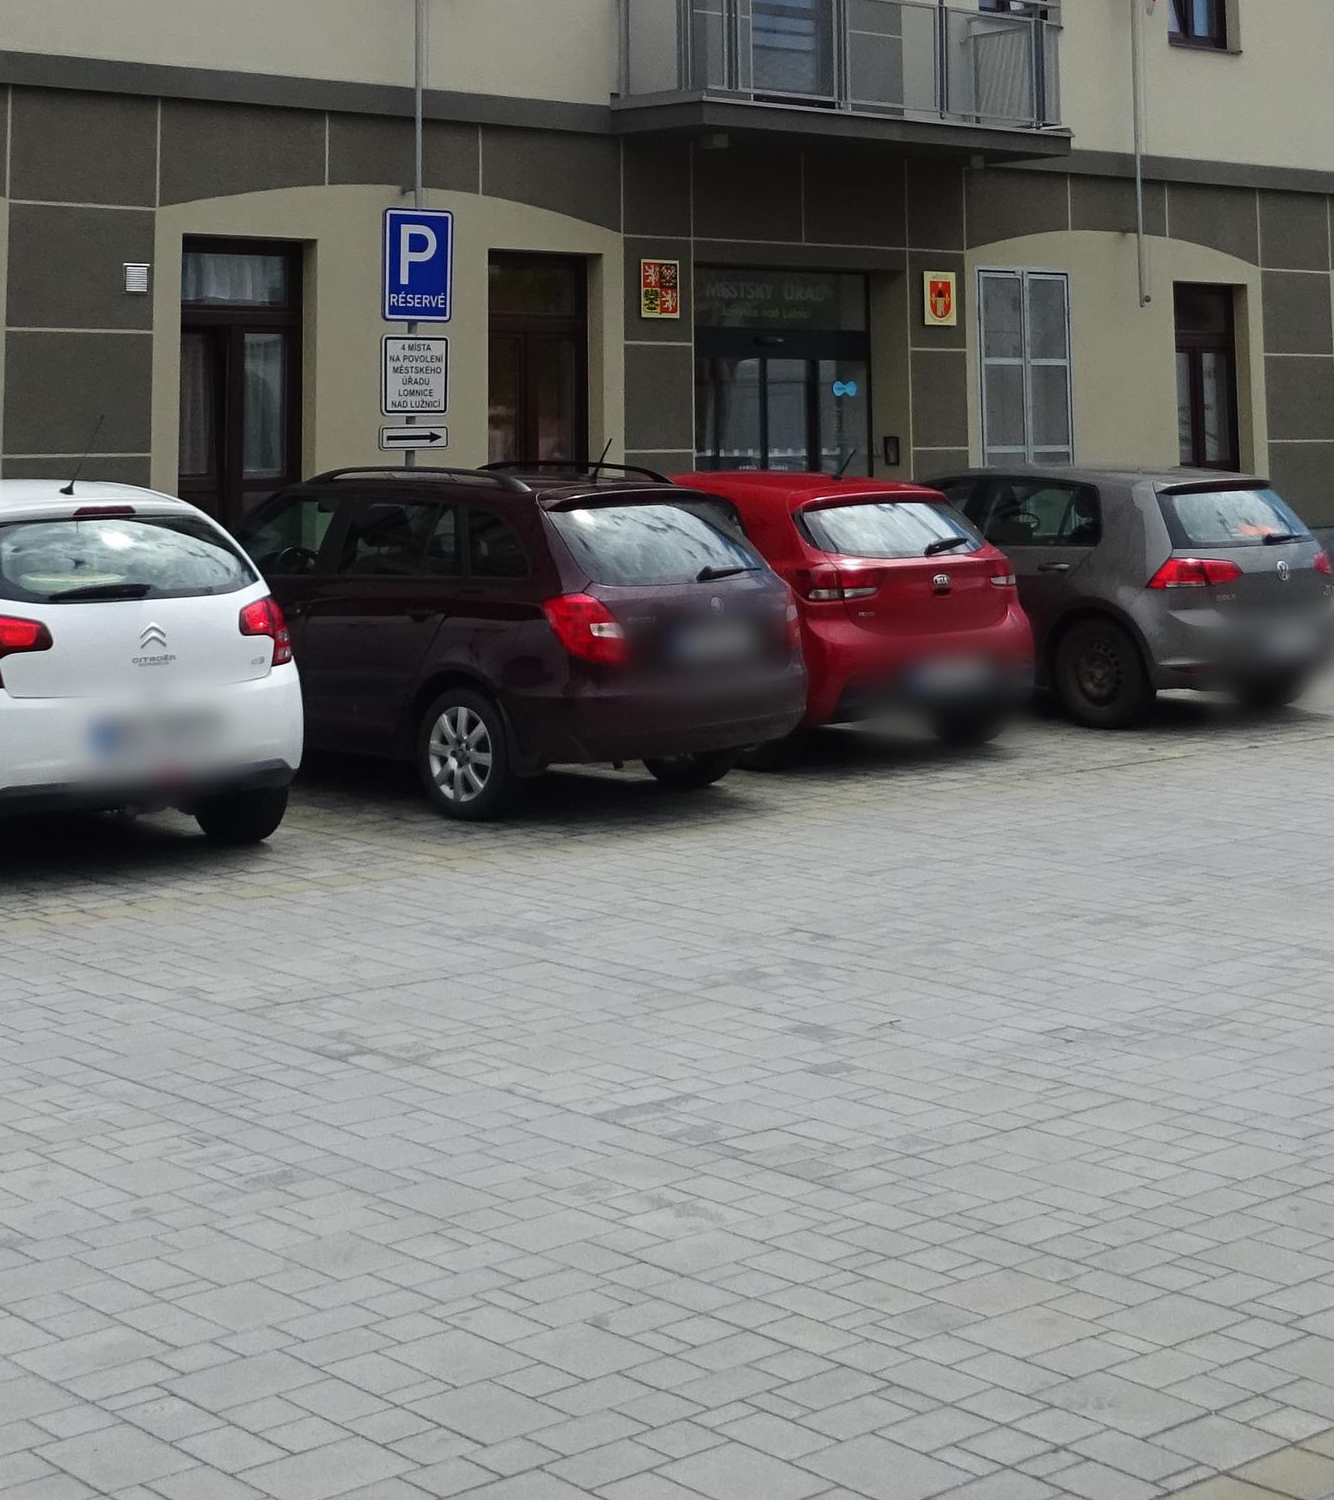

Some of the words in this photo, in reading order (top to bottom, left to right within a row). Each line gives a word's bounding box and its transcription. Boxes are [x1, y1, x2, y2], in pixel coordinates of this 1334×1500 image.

[400, 223, 437, 285] P
[389, 291, 446, 308] RÉSERVÉ
[401, 344, 406, 352] 4
[408, 342, 431, 352] MÍSTA
[389, 355, 401, 363] NA
[402, 353, 443, 363] POVOLENÍ
[402, 375, 430, 386] ÚŘADU
[398, 388, 434, 397] LOMNICE
[391, 400, 407, 409] NAD
[409, 398, 441, 409] LUŽNICÍ
